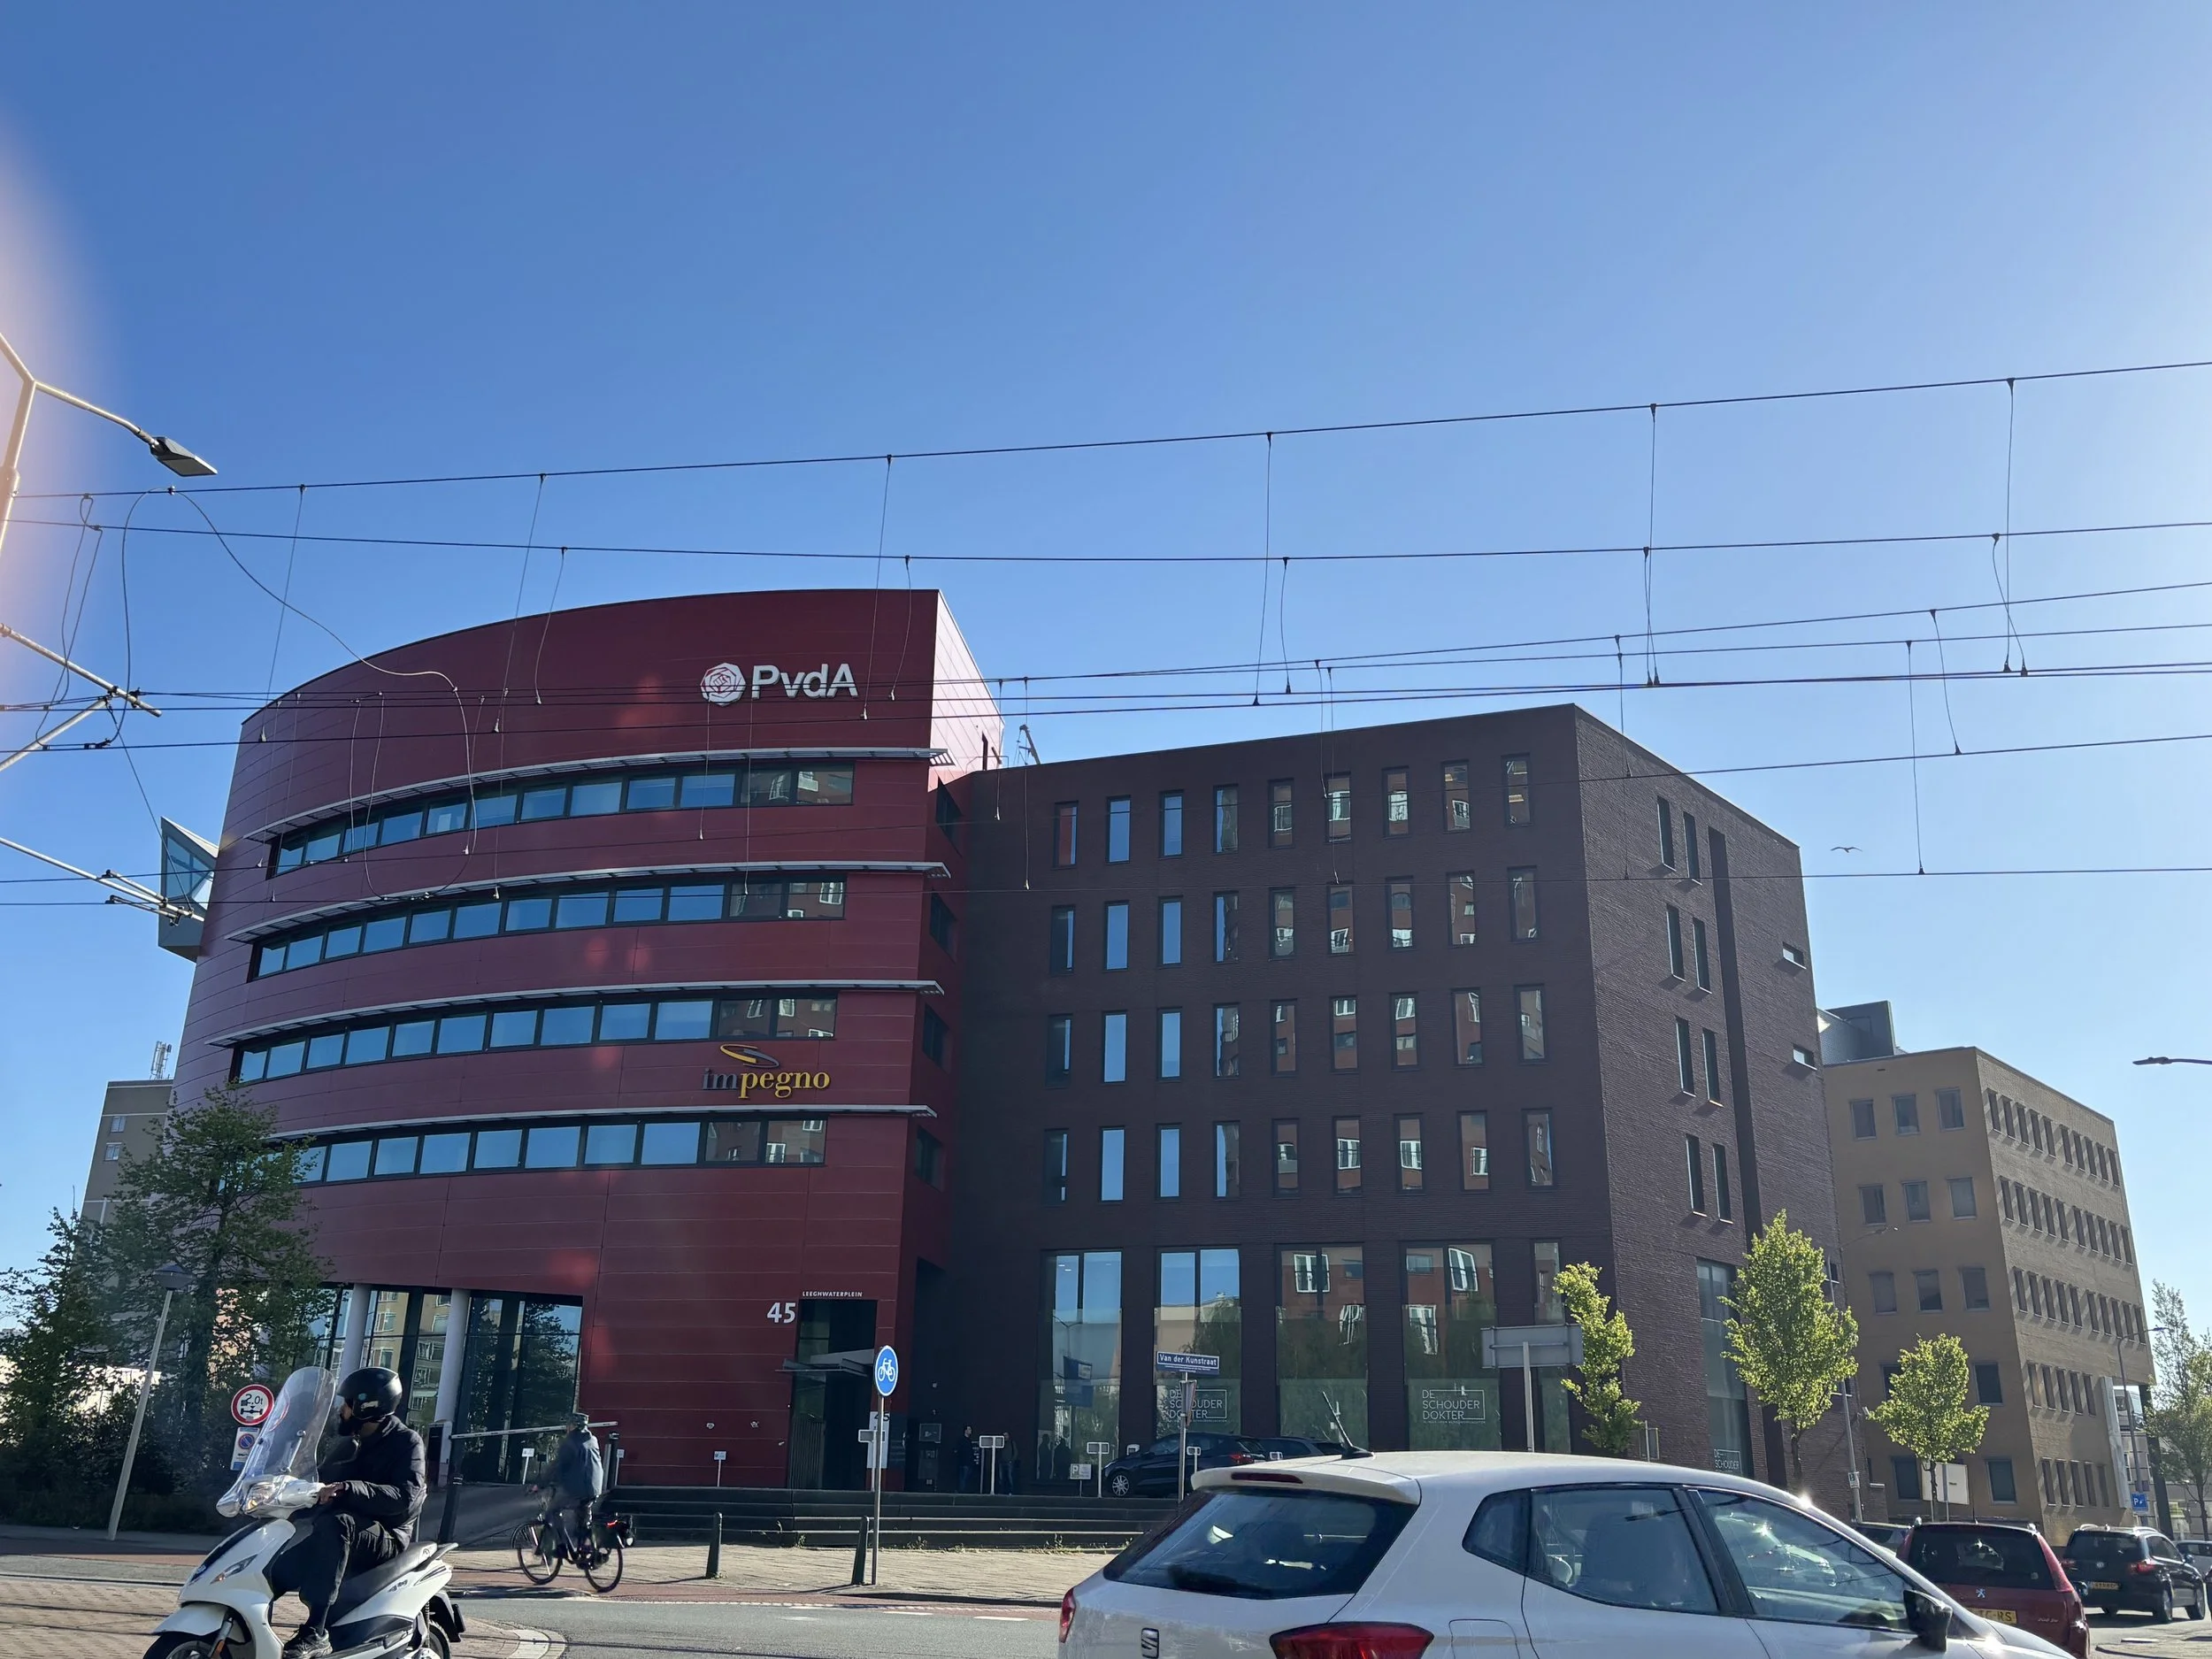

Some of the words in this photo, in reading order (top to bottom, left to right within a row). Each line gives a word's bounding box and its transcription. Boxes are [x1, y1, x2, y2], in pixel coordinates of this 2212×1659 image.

[752, 664, 858, 699] PvdA
[703, 1068, 831, 1098] impegno
[766, 1302, 796, 1324] 45
[1186, 1356, 1217, 1366] Kunstraat
[1422, 1389, 1435, 1399] DE
[1169, 1399, 1223, 1409] SCOUDER
[1422, 1400, 1480, 1409] SCHOUDER
[1169, 1409, 1208, 1419] DOTER
[1422, 1410, 1464, 1420] DOKTER
